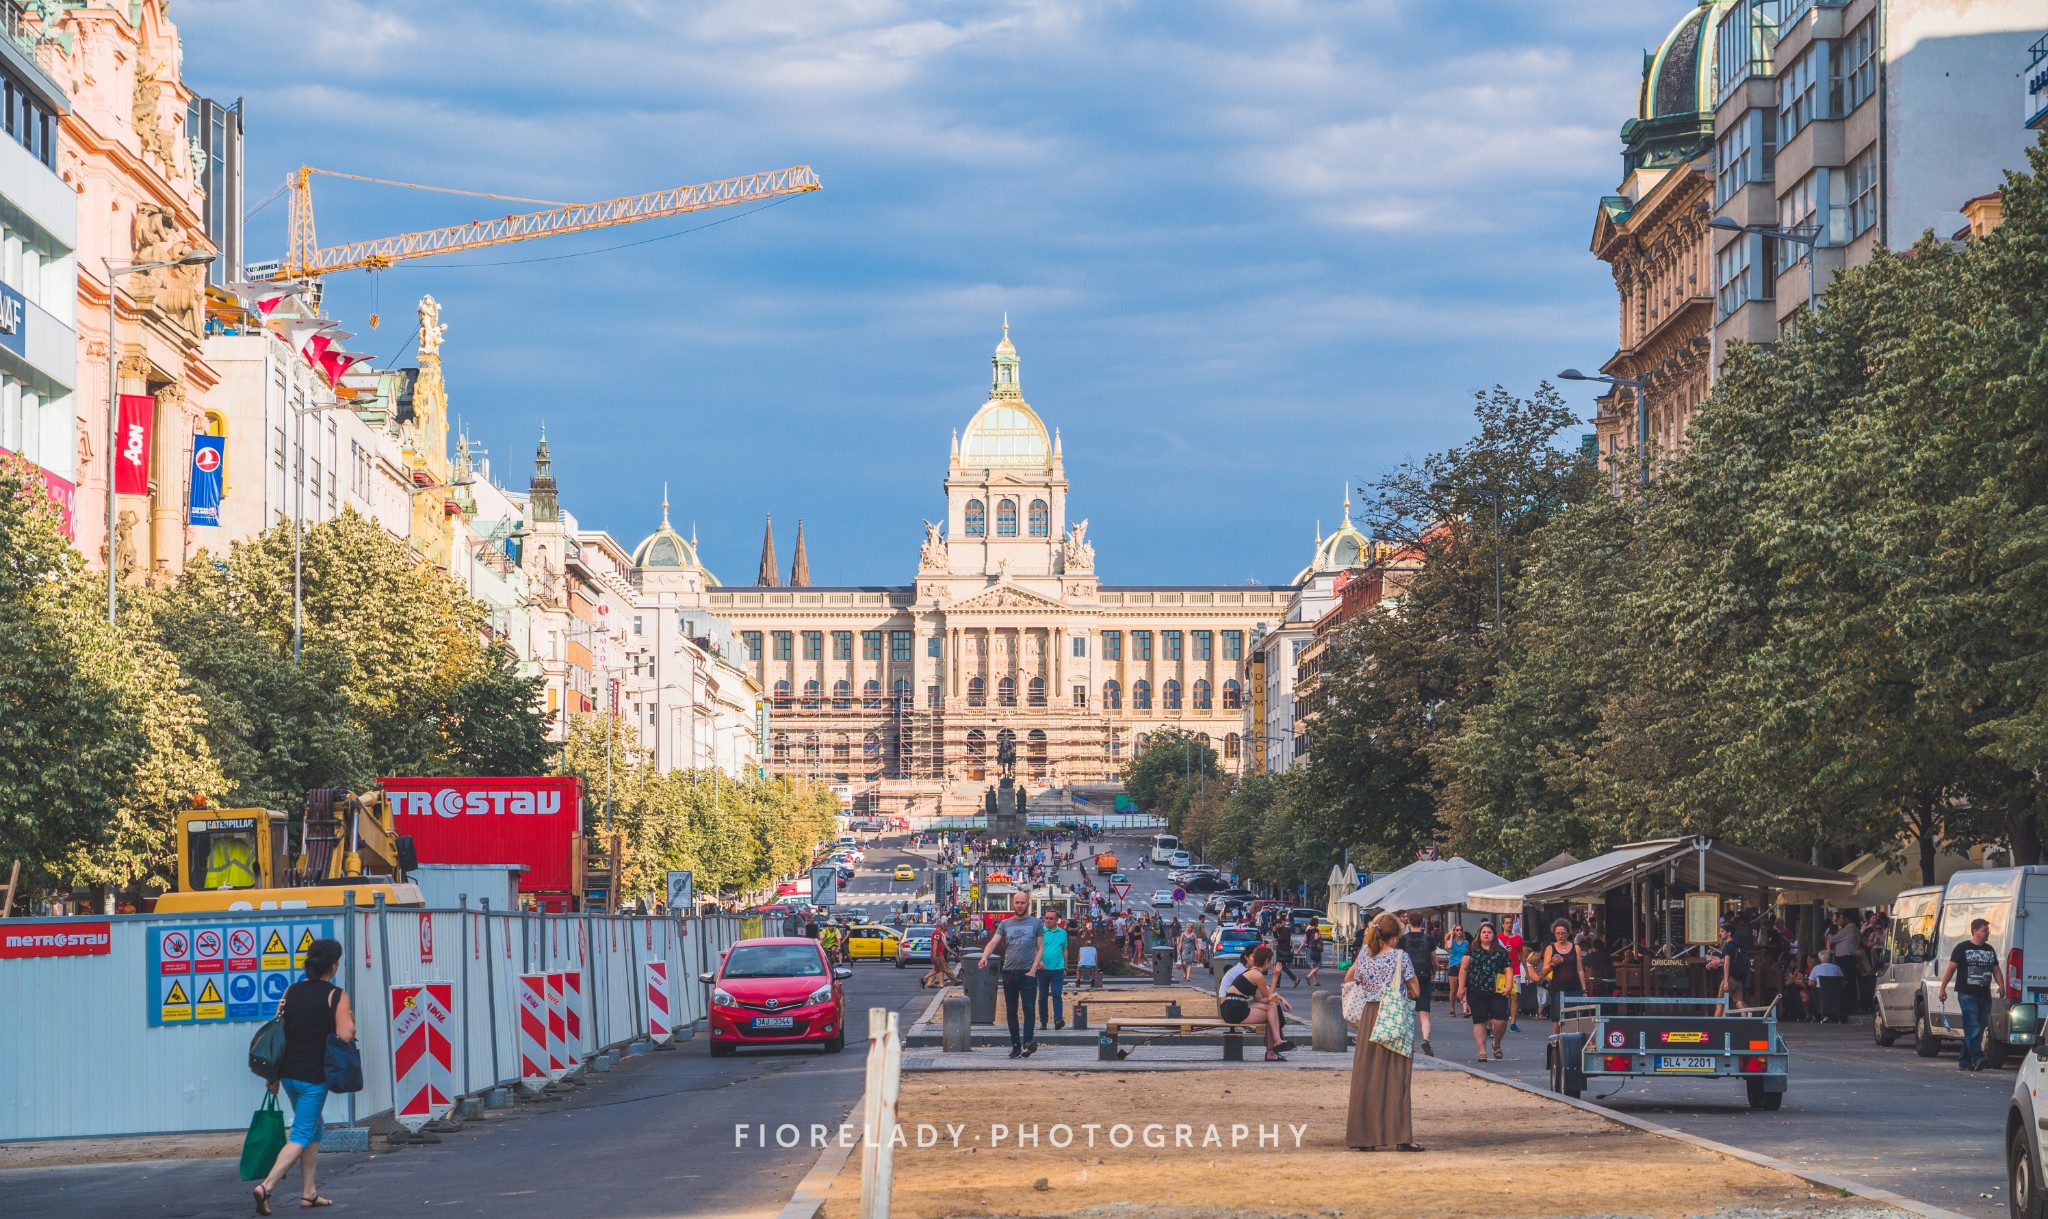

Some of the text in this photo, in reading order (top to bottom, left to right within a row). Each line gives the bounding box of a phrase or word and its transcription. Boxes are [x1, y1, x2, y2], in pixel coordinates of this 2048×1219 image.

[123, 423, 144, 466] AON
[207, 819, 254, 830] CATERPILLAR
[1610, 1034, 1623, 1042] 130
[1663, 1058, 1711, 1068] 5L4 2201
